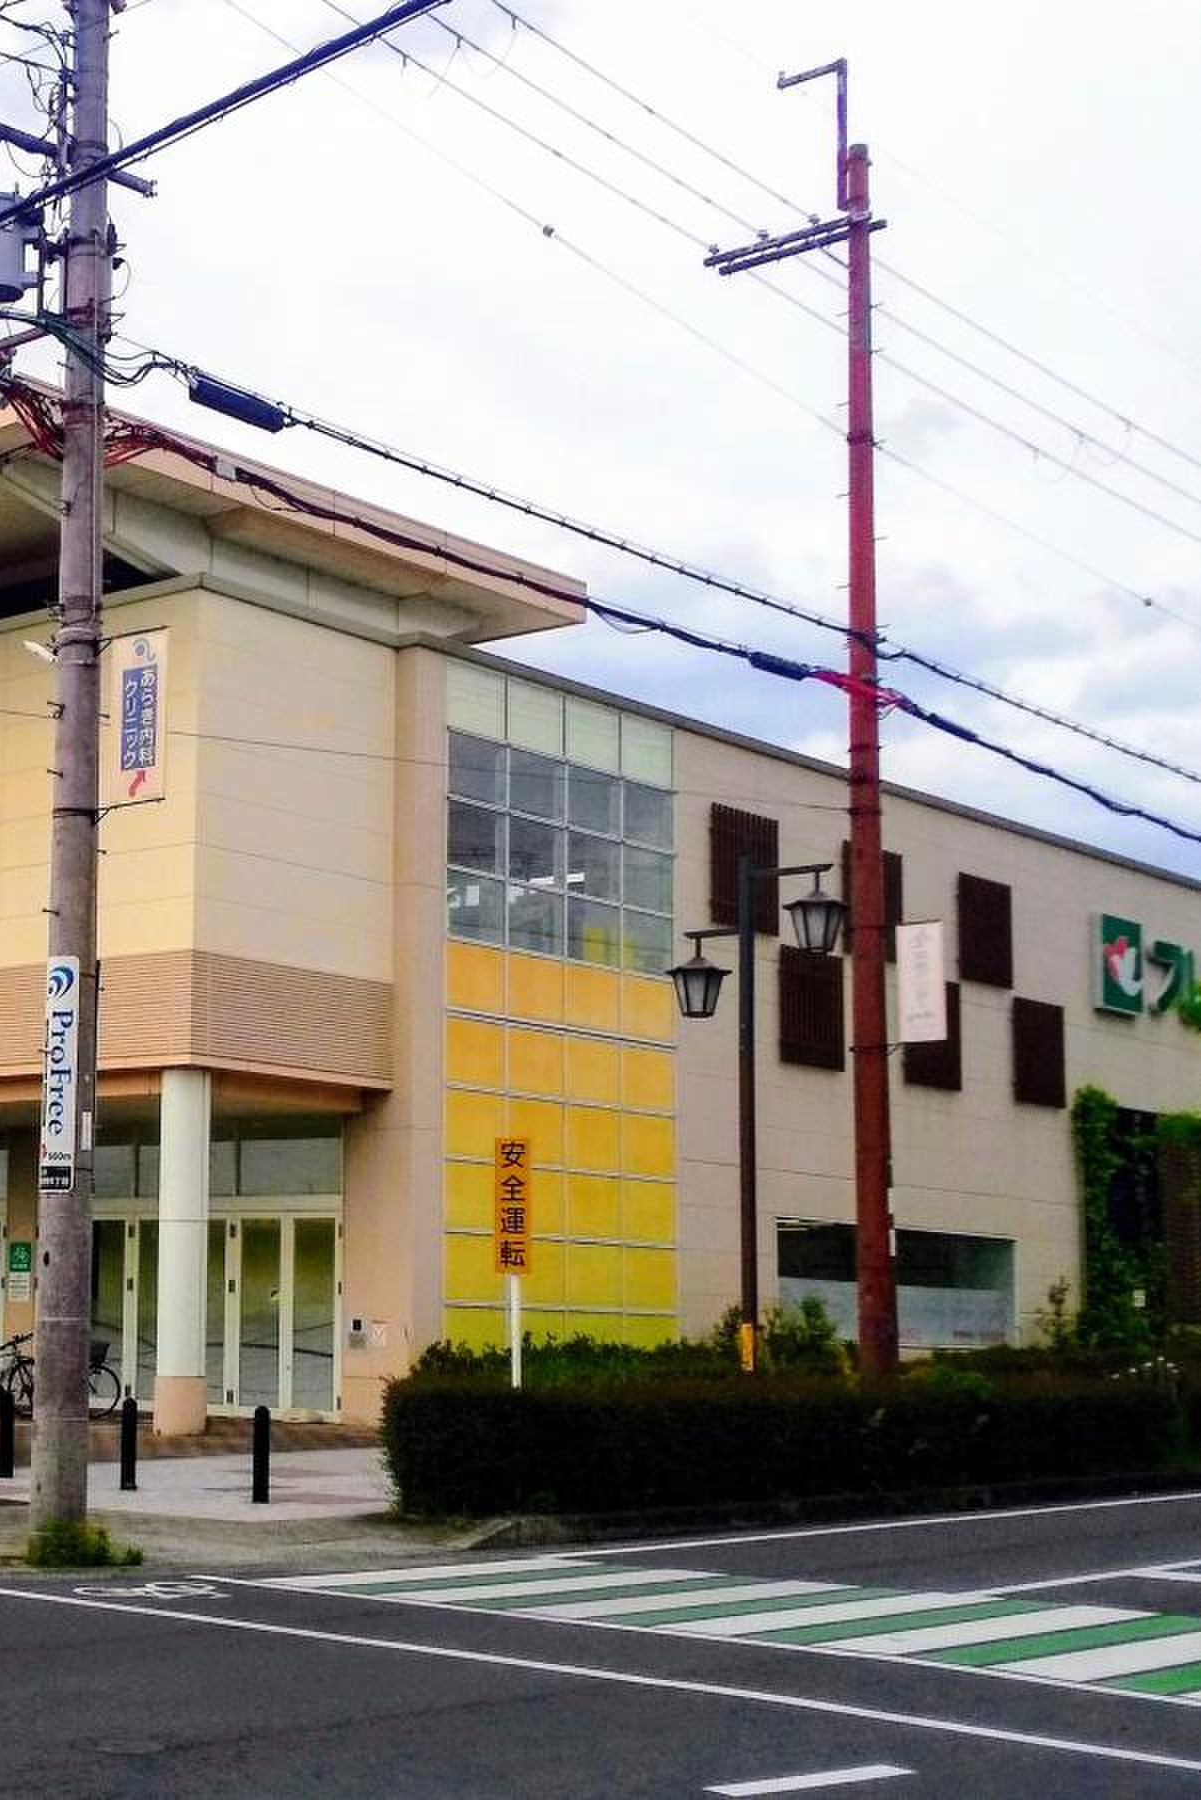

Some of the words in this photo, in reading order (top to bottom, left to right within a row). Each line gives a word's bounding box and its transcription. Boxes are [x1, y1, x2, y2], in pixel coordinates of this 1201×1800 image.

[48, 1010, 74, 1136] ProFree
[500, 1142, 526, 1268] 安全運転
